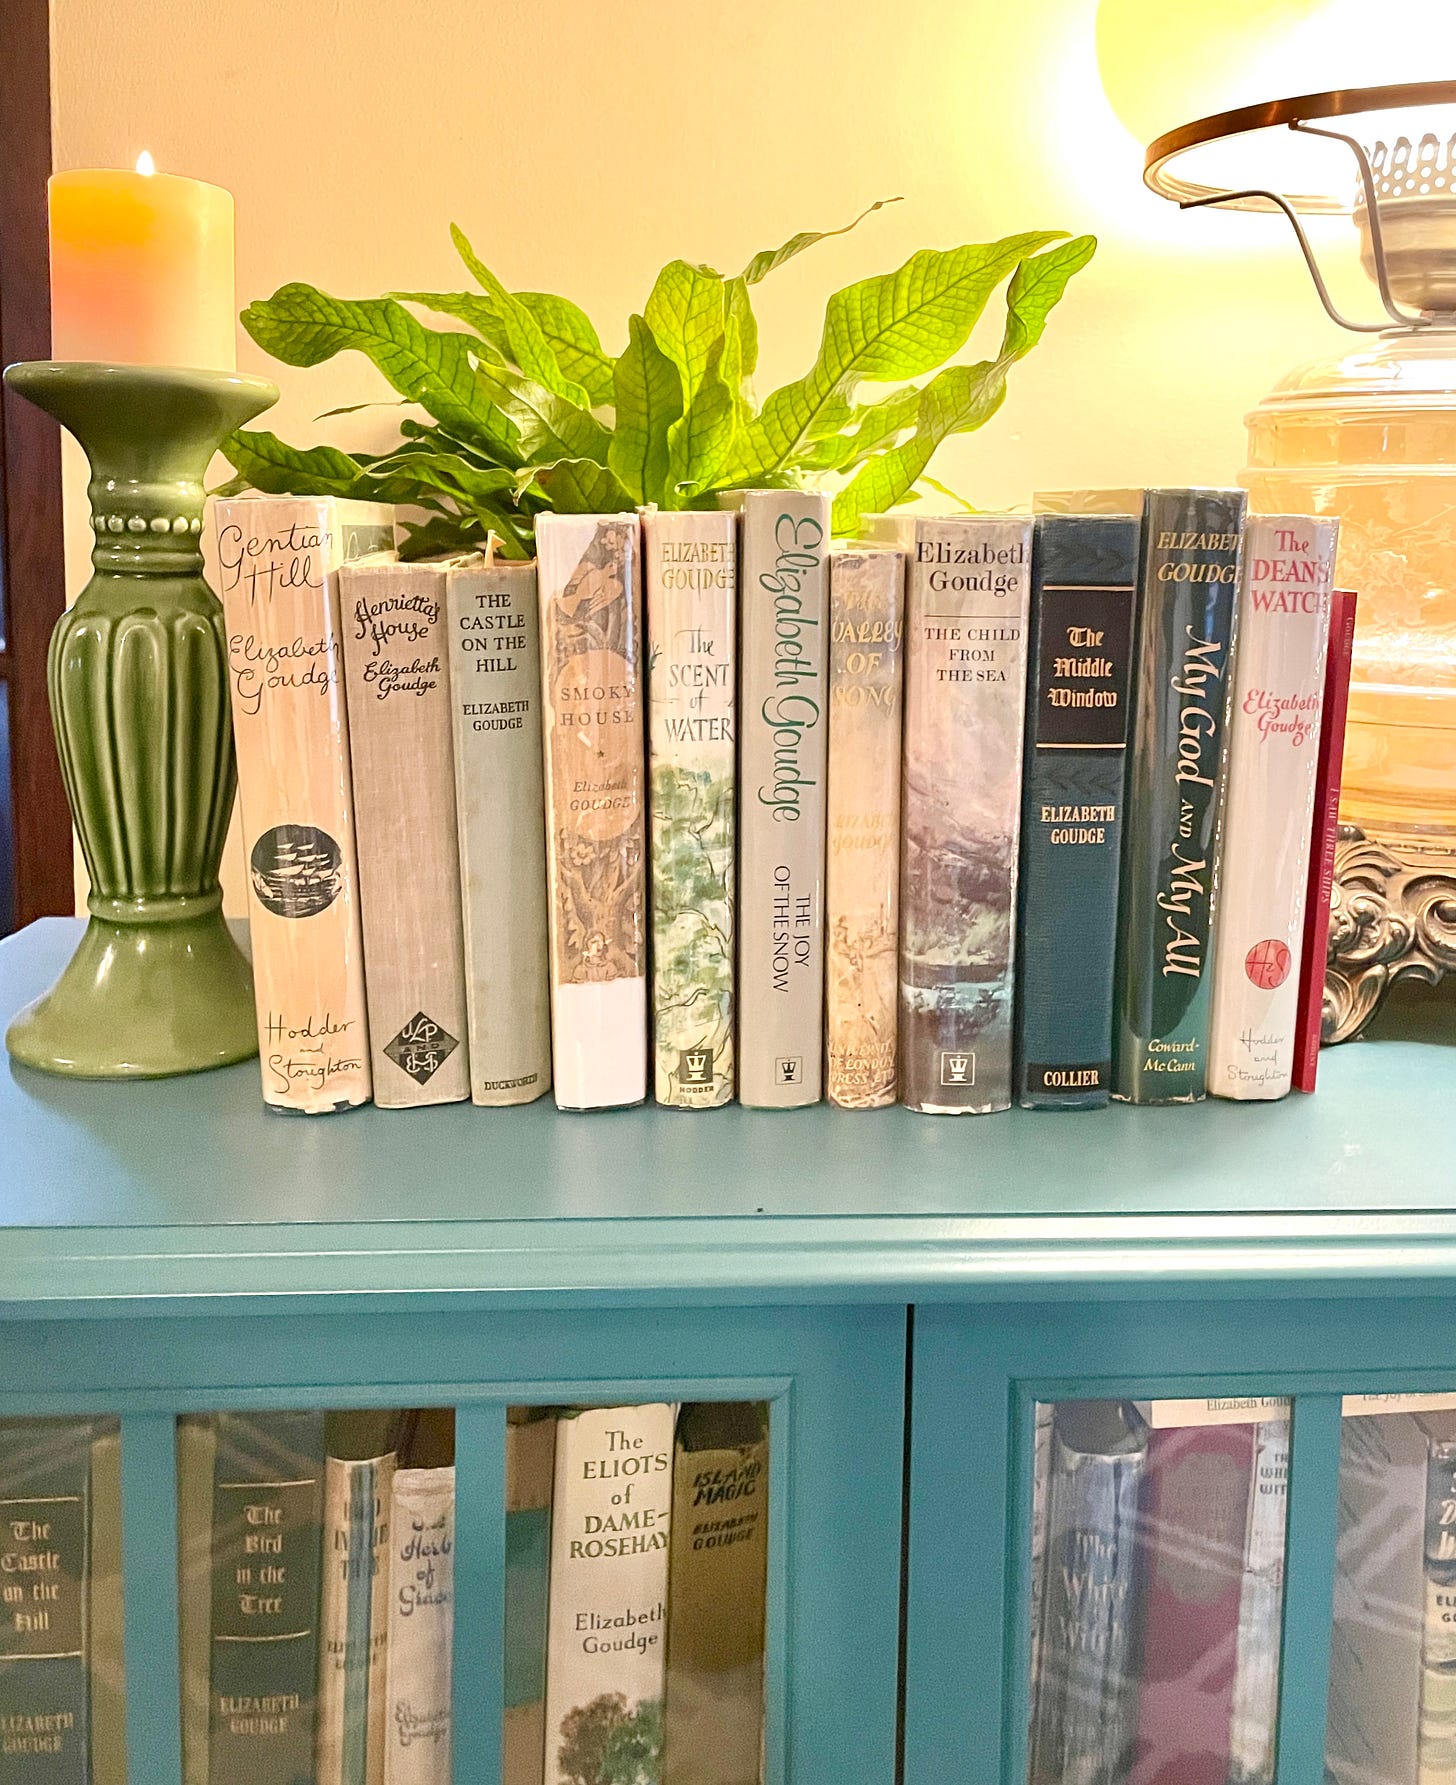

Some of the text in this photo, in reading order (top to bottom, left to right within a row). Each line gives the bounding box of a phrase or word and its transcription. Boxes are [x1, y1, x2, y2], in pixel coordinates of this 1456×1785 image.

[1157, 531, 1242, 551] ELIZABET
[1275, 530, 1309, 555] The
[219, 523, 333, 591] Gentian
[661, 543, 736, 563] ELIZABETH
[1252, 555, 1330, 583] DEAN'S
[244, 555, 325, 607] Hill
[662, 568, 736, 598] GOUDGE
[929, 570, 1018, 598] Goudge
[475, 594, 512, 609] THE
[1251, 589, 1328, 614] WATCH
[355, 594, 441, 640] Henrietta's
[460, 614, 526, 630] CASTLE
[371, 620, 429, 656] House
[461, 635, 526, 652] ON THE
[675, 625, 714, 656] The
[924, 628, 1020, 641] THE CHILD
[1066, 626, 1104, 648] The
[229, 633, 340, 672] Elizabeth
[949, 649, 995, 661] FROM
[364, 657, 441, 682] Elizabeth
[476, 658, 518, 673] HILL
[758, 513, 824, 823] Elizabeth Goudge
[846, 652, 882, 676] OF
[1054, 657, 1113, 679] Middle
[669, 664, 729, 687] SCENT
[937, 669, 1006, 682] THE SEA
[237, 663, 340, 714] Goudge
[377, 677, 437, 700] Goudge
[561, 685, 633, 701] SMOKY
[690, 688, 710, 711] of
[1048, 688, 1117, 708] Window
[463, 700, 529, 716] ELIZABETH
[1243, 688, 1320, 719] Elizabeth
[473, 717, 523, 732] GOUDGE
[560, 710, 634, 726] HOUSE
[1258, 711, 1312, 747] Goudge
[664, 717, 735, 742] WATER
[573, 779, 628, 793] Elizabeth
[570, 797, 631, 811] GOUDGE
[1157, 624, 1222, 978] My God AND My All
[1040, 805, 1116, 823] ELIZABETH
[1050, 828, 1105, 844] GOUDGE
[1323, 827, 1335, 866] THREE
[1320, 869, 1331, 904] SHIPS
[772, 866, 791, 993] OF THE SNOW
[793, 893, 811, 968] THE JOY
[264, 1010, 356, 1046] Hodder
[300, 1042, 325, 1054] and
[1148, 1038, 1200, 1053] Coward-
[1240, 1028, 1285, 1052] Hodder
[269, 1055, 362, 1094] Stoughton
[1043, 1070, 1100, 1087] COLLIER
[1227, 1065, 1289, 1086] Stoughton
[679, 1085, 715, 1094] HODDER
[605, 1430, 643, 1451] The
[583, 1453, 667, 1479] ELIOTS
[693, 1462, 761, 1488] ISLAND
[611, 1483, 634, 1505] of
[693, 1480, 756, 1507] MAGIC
[244, 1505, 282, 1525] The
[585, 1509, 669, 1534] DAME-
[10, 1521, 50, 1541] The
[246, 1534, 282, 1553] Bird
[401, 1533, 453, 1561] Herb
[570, 1531, 669, 1558] ROSEHAY
[1, 1552, 60, 1572] Castle
[237, 1565, 285, 1585] in the
[416, 1559, 436, 1589] of
[33, 1581, 59, 1600] the
[239, 1594, 282, 1615] Tree
[15, 1612, 49, 1631] Hill
[583, 1632, 658, 1656] Goudge
[220, 1694, 299, 1713] ELIZABETH
[0, 1712, 74, 1732] LIZABETH
[230, 1717, 288, 1736] GOUDGE
